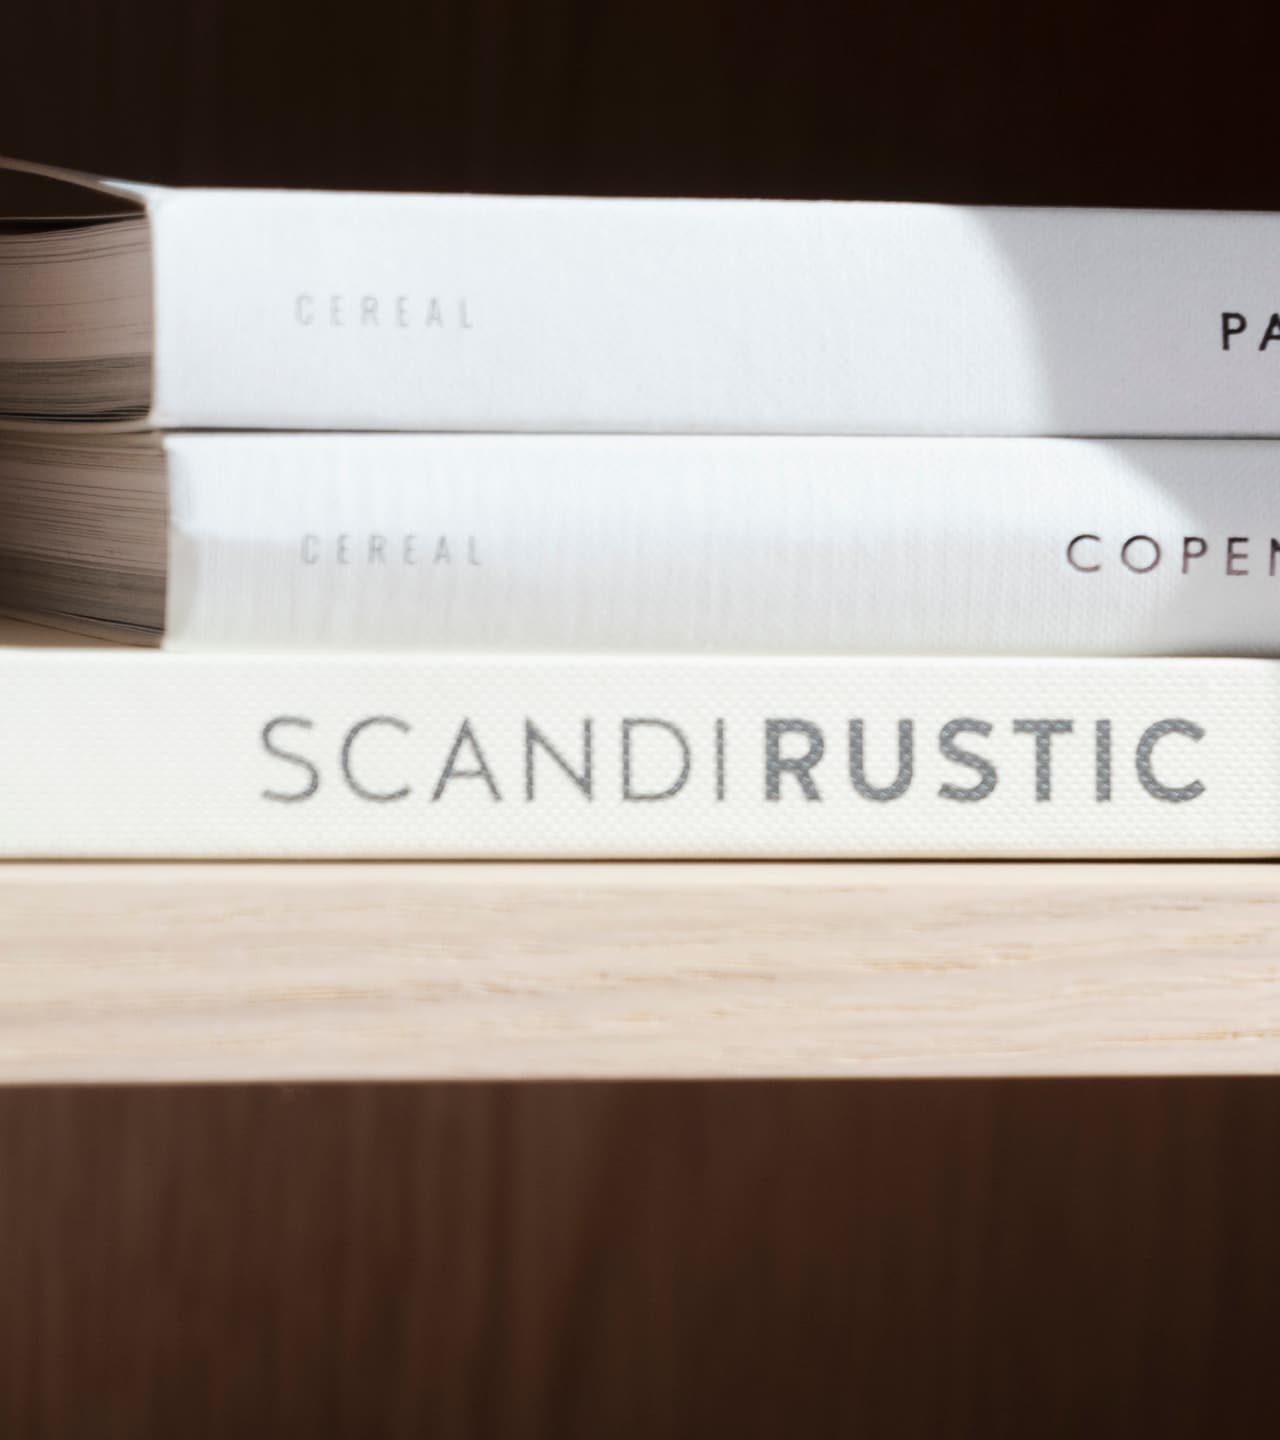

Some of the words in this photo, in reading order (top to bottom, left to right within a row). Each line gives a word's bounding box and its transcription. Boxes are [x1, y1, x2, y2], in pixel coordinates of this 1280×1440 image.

[294, 292, 473, 330] CEREAL
[300, 533, 483, 568] CEREAL
[260, 716, 1207, 805] SCANDIRUSTIC
